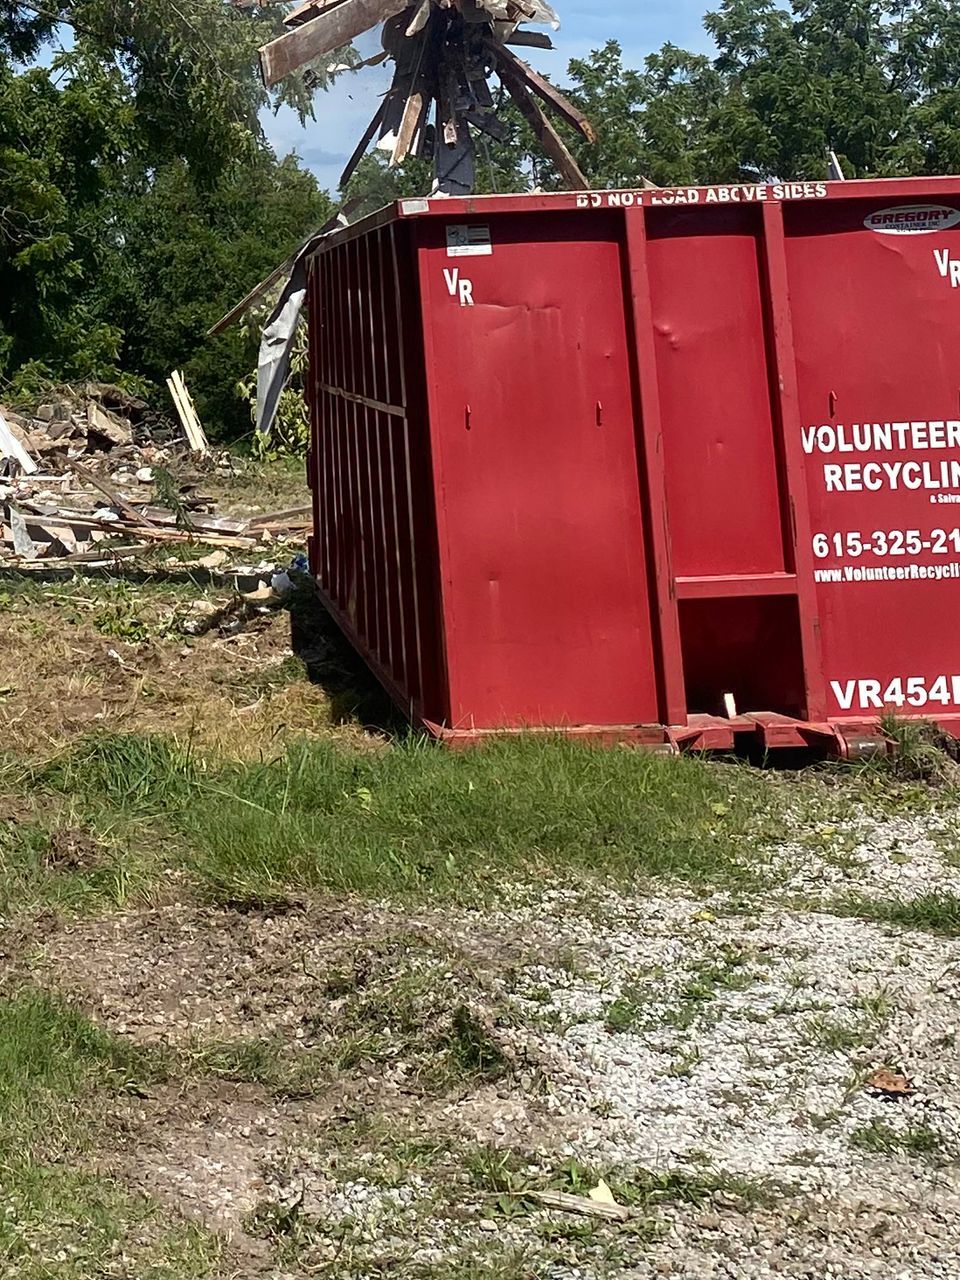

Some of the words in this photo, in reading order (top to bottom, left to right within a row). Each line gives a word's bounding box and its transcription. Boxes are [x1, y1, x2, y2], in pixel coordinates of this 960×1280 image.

[576, 193, 602, 208] DO
[607, 191, 643, 207] NOT
[651, 189, 700, 205] LOAD
[705, 186, 768, 203] ABOVE
[772, 183, 827, 200] SIDES
[870, 209, 954, 225] GREGORY
[800, 420, 960, 454] VOLUNTEER
